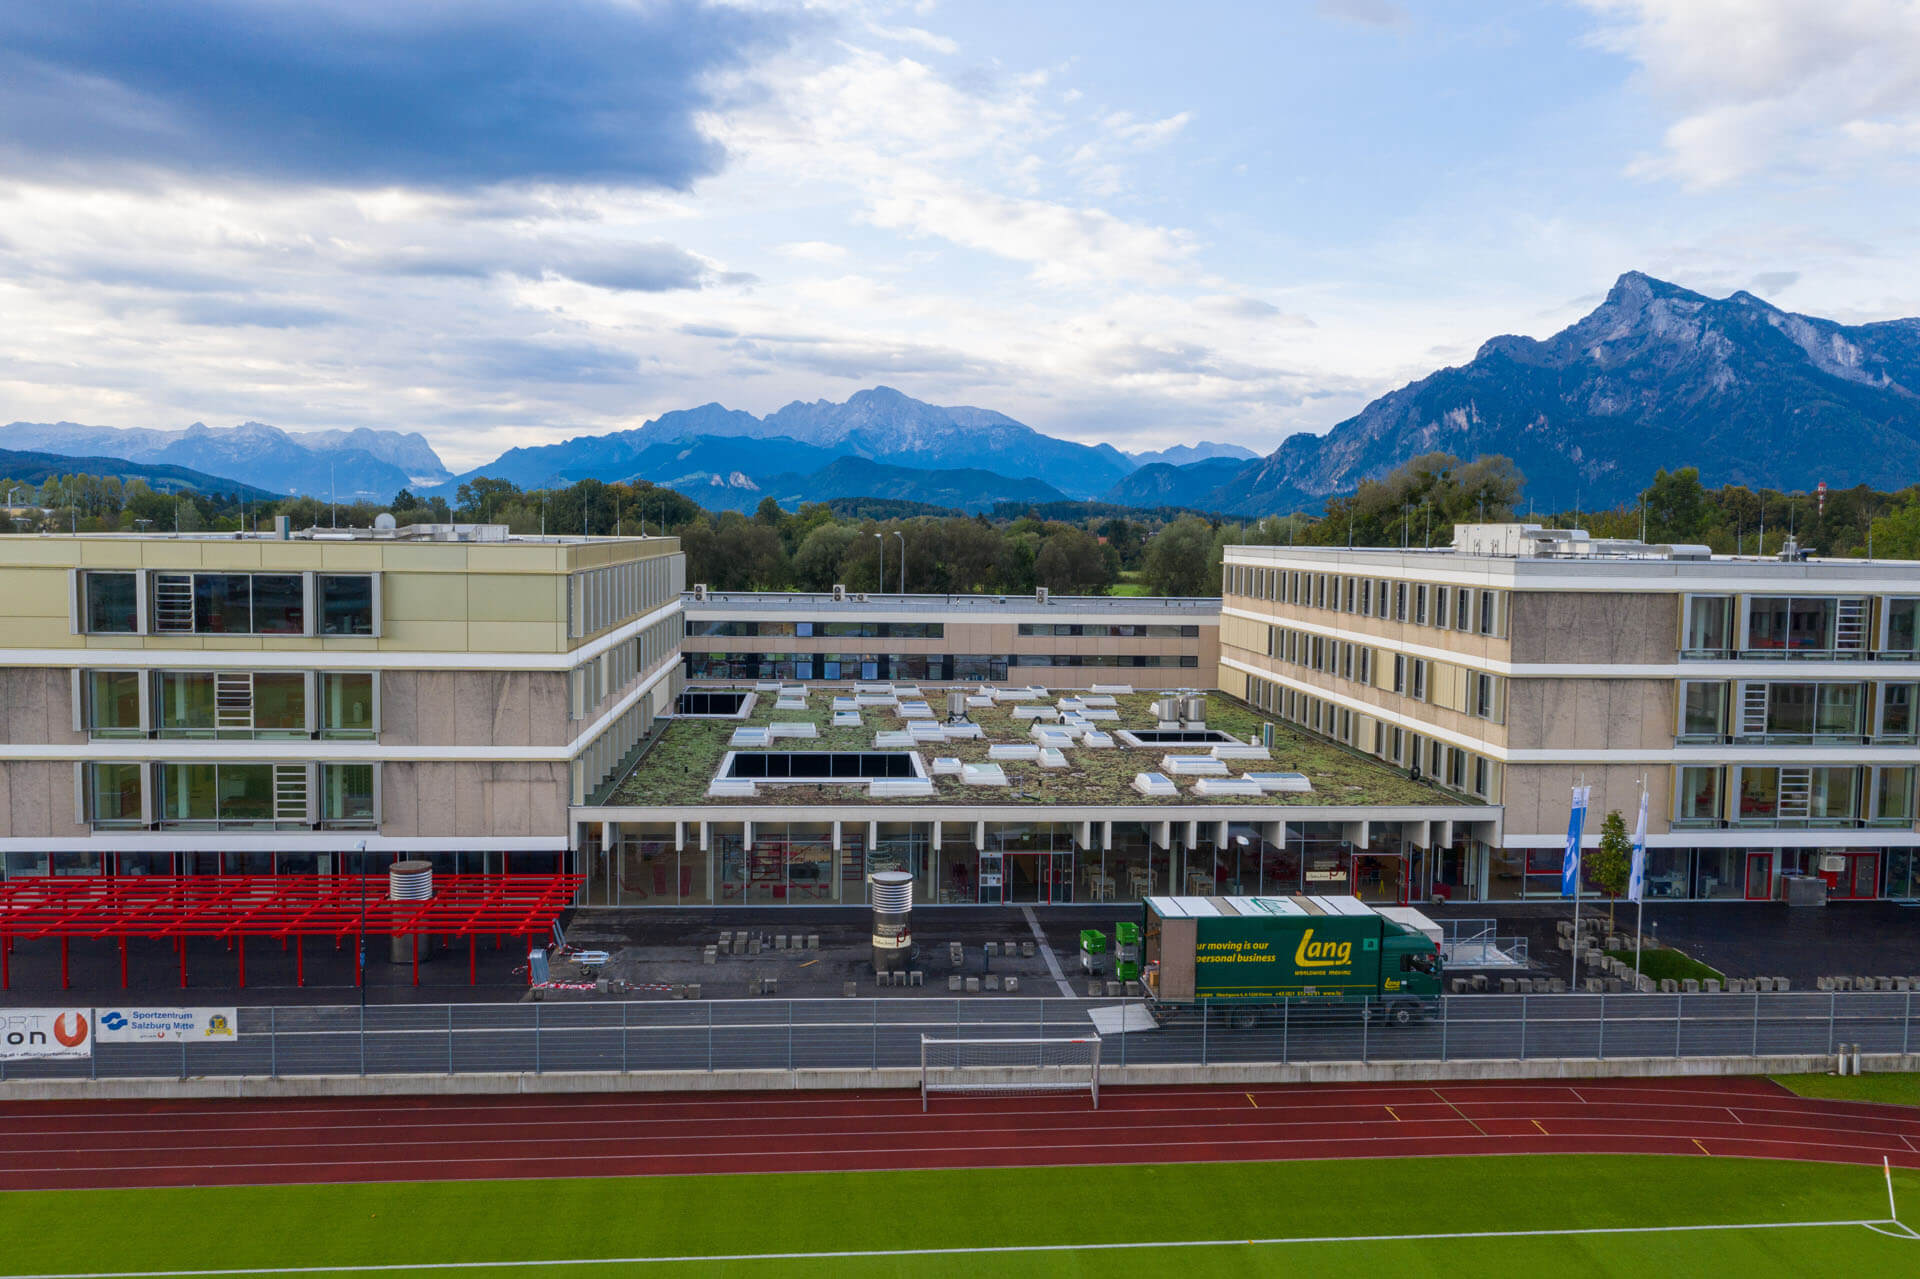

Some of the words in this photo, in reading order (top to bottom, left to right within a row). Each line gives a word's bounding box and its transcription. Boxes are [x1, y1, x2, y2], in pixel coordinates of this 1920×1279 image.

[1208, 941, 1242, 951] moving
[1244, 940, 1251, 950] is
[1295, 928, 1352, 967] Lang
[1238, 953, 1276, 962] business
[132, 1011, 193, 1021] Sportzentrum
[131, 1022, 171, 1030] Salzburg
[173, 1021, 195, 1029] Mitte
